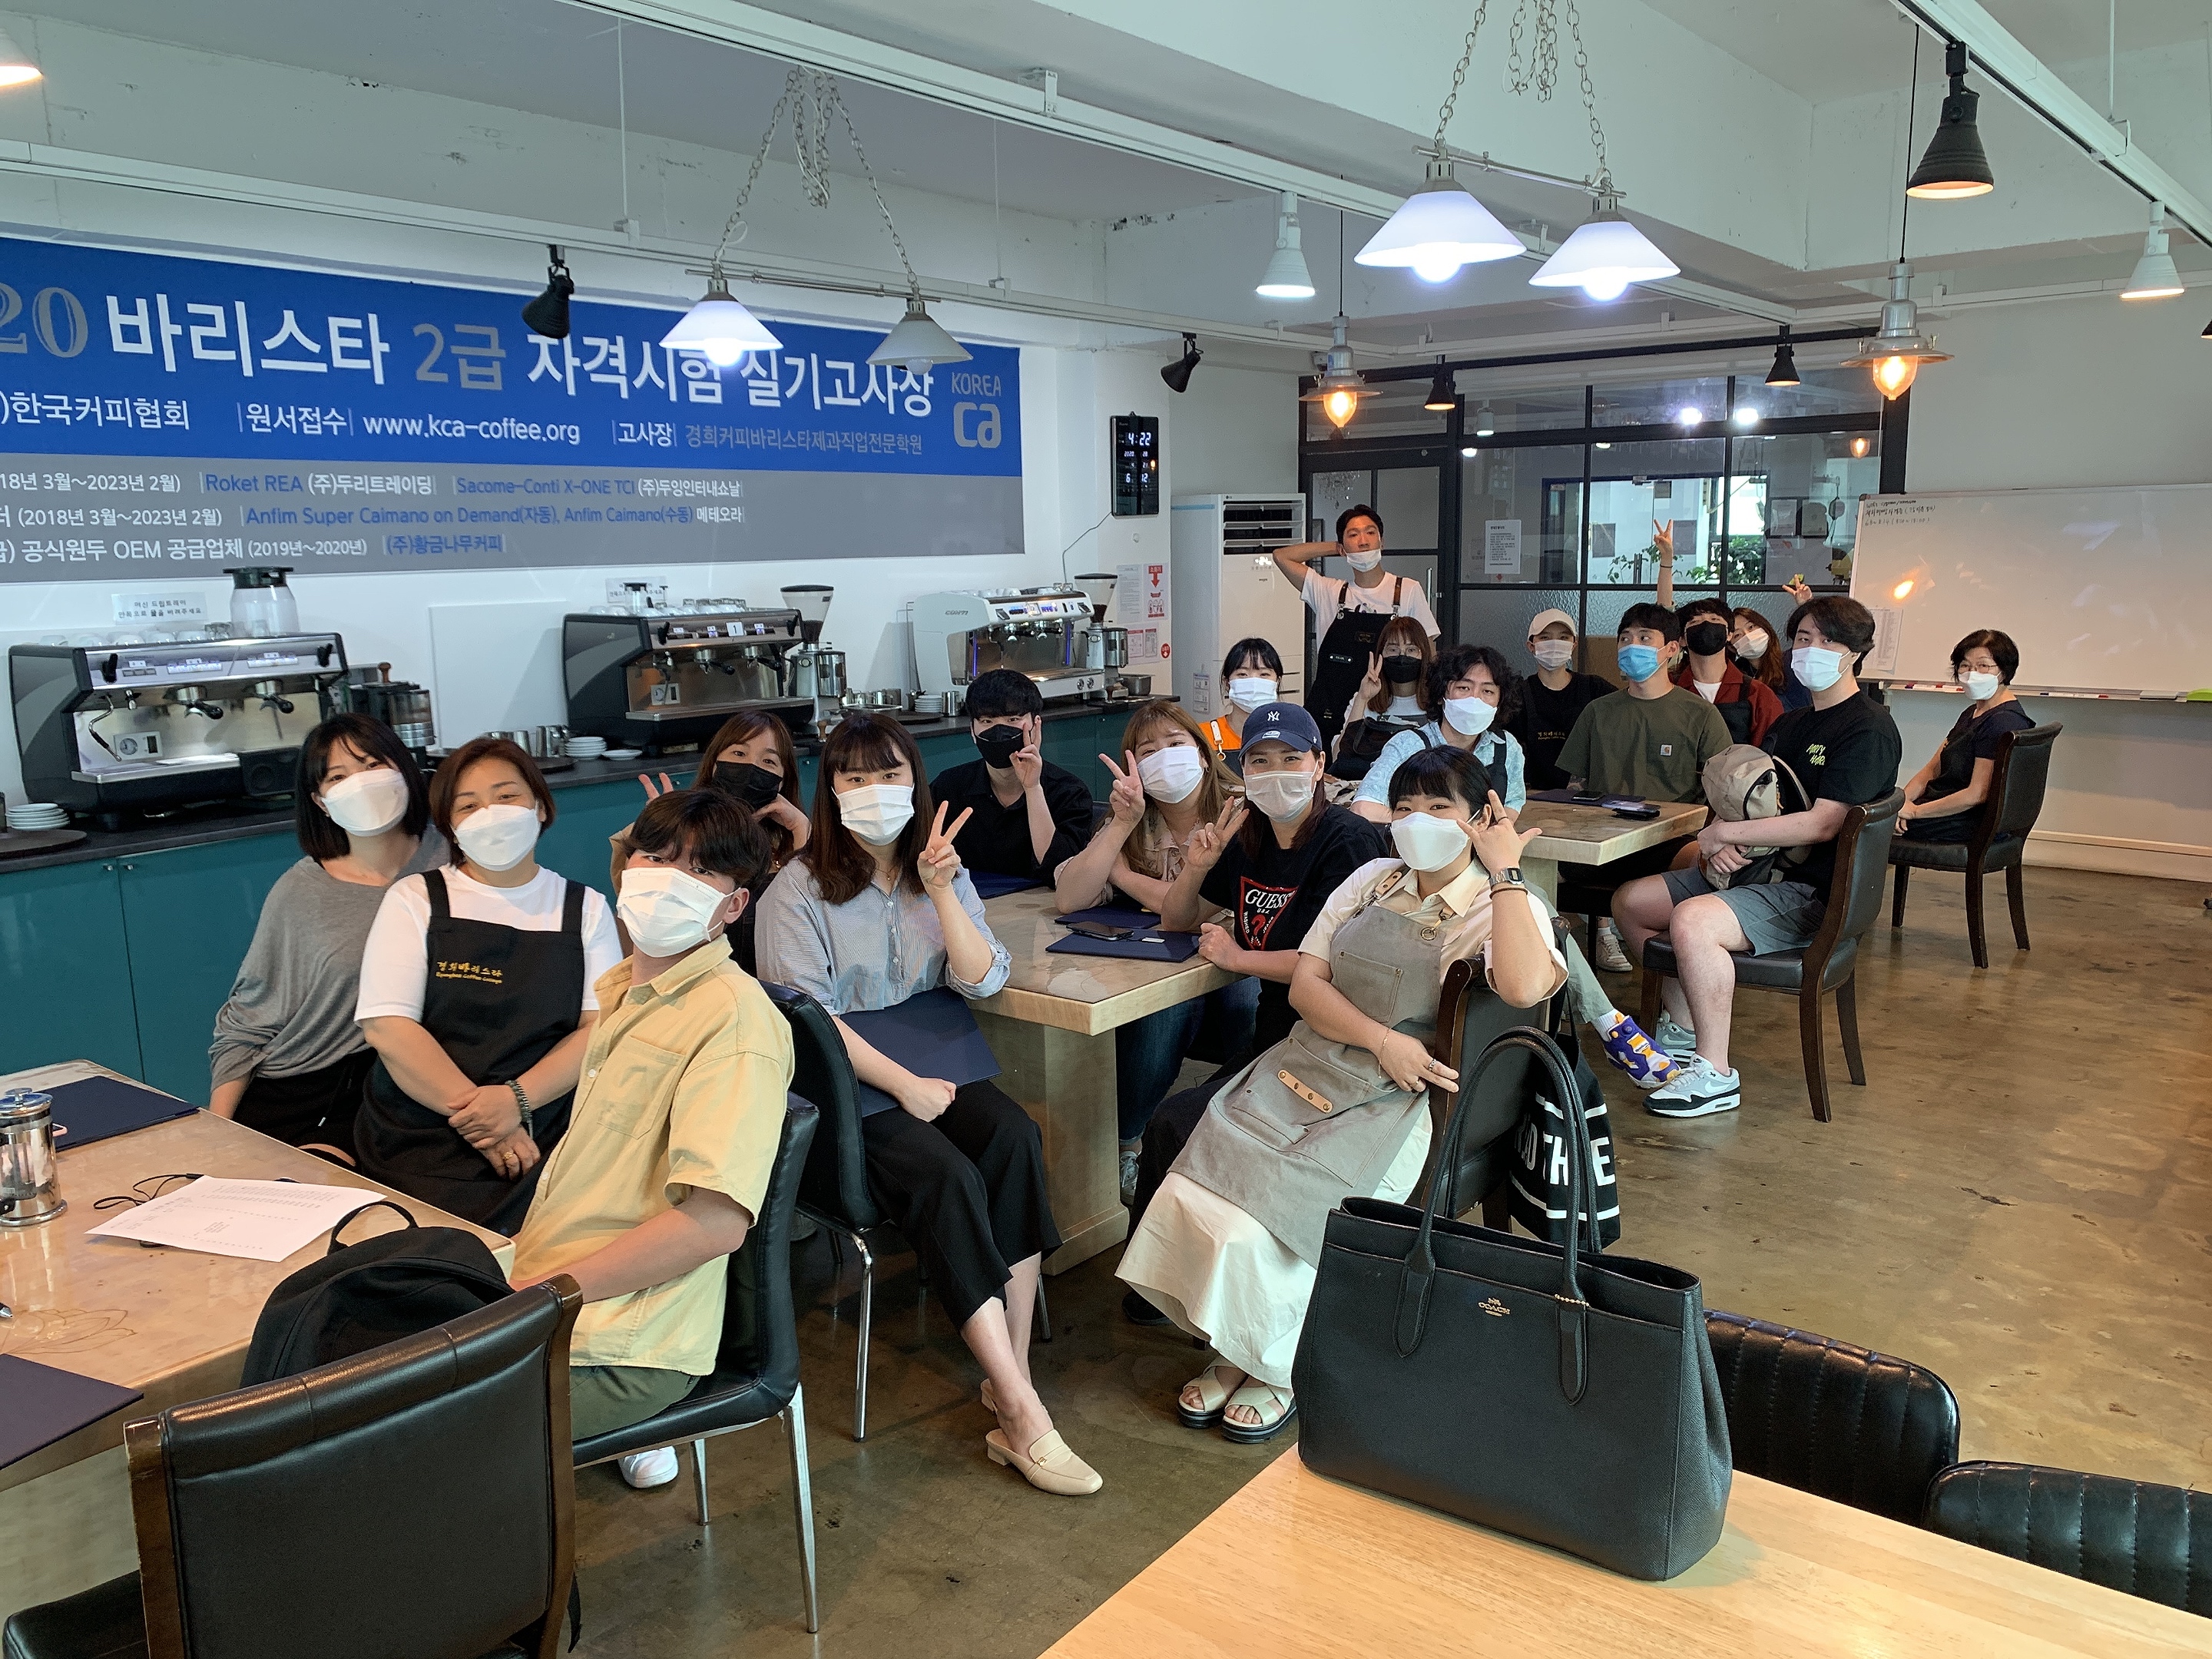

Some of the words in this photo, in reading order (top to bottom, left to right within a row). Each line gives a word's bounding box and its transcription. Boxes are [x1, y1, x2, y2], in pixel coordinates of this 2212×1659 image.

[106, 293, 390, 385] 바리스타
[412, 323, 506, 390] 2급
[526, 333, 724, 405] 자격시험
[740, 349, 935, 418] 실기고사장
[951, 371, 1002, 397] KOREA
[245, 401, 347, 436] 원서접수
[363, 414, 581, 445] www.kca-coffee.org
[618, 420, 674, 448] 고사장
[1128, 432, 1151, 446] 4:22
[149, 474, 180, 493] 2월)
[205, 474, 258, 492] Roket
[265, 475, 303, 492] REA
[564, 478, 611, 495] X-ONE
[191, 508, 222, 527] 2월)
[246, 507, 297, 525] Anfim
[303, 508, 353, 527] Super
[359, 508, 429, 525] Caimano
[434, 512, 452, 525] on
[565, 506, 602, 523] Anfim
[22, 539, 107, 562] 공식원두
[114, 540, 161, 559] OEM
[167, 538, 243, 560] 공급업체
[1267, 710, 1280, 722] NY
[1245, 889, 1291, 909] GUESS
[1478, 1302, 1511, 1315] COACH
